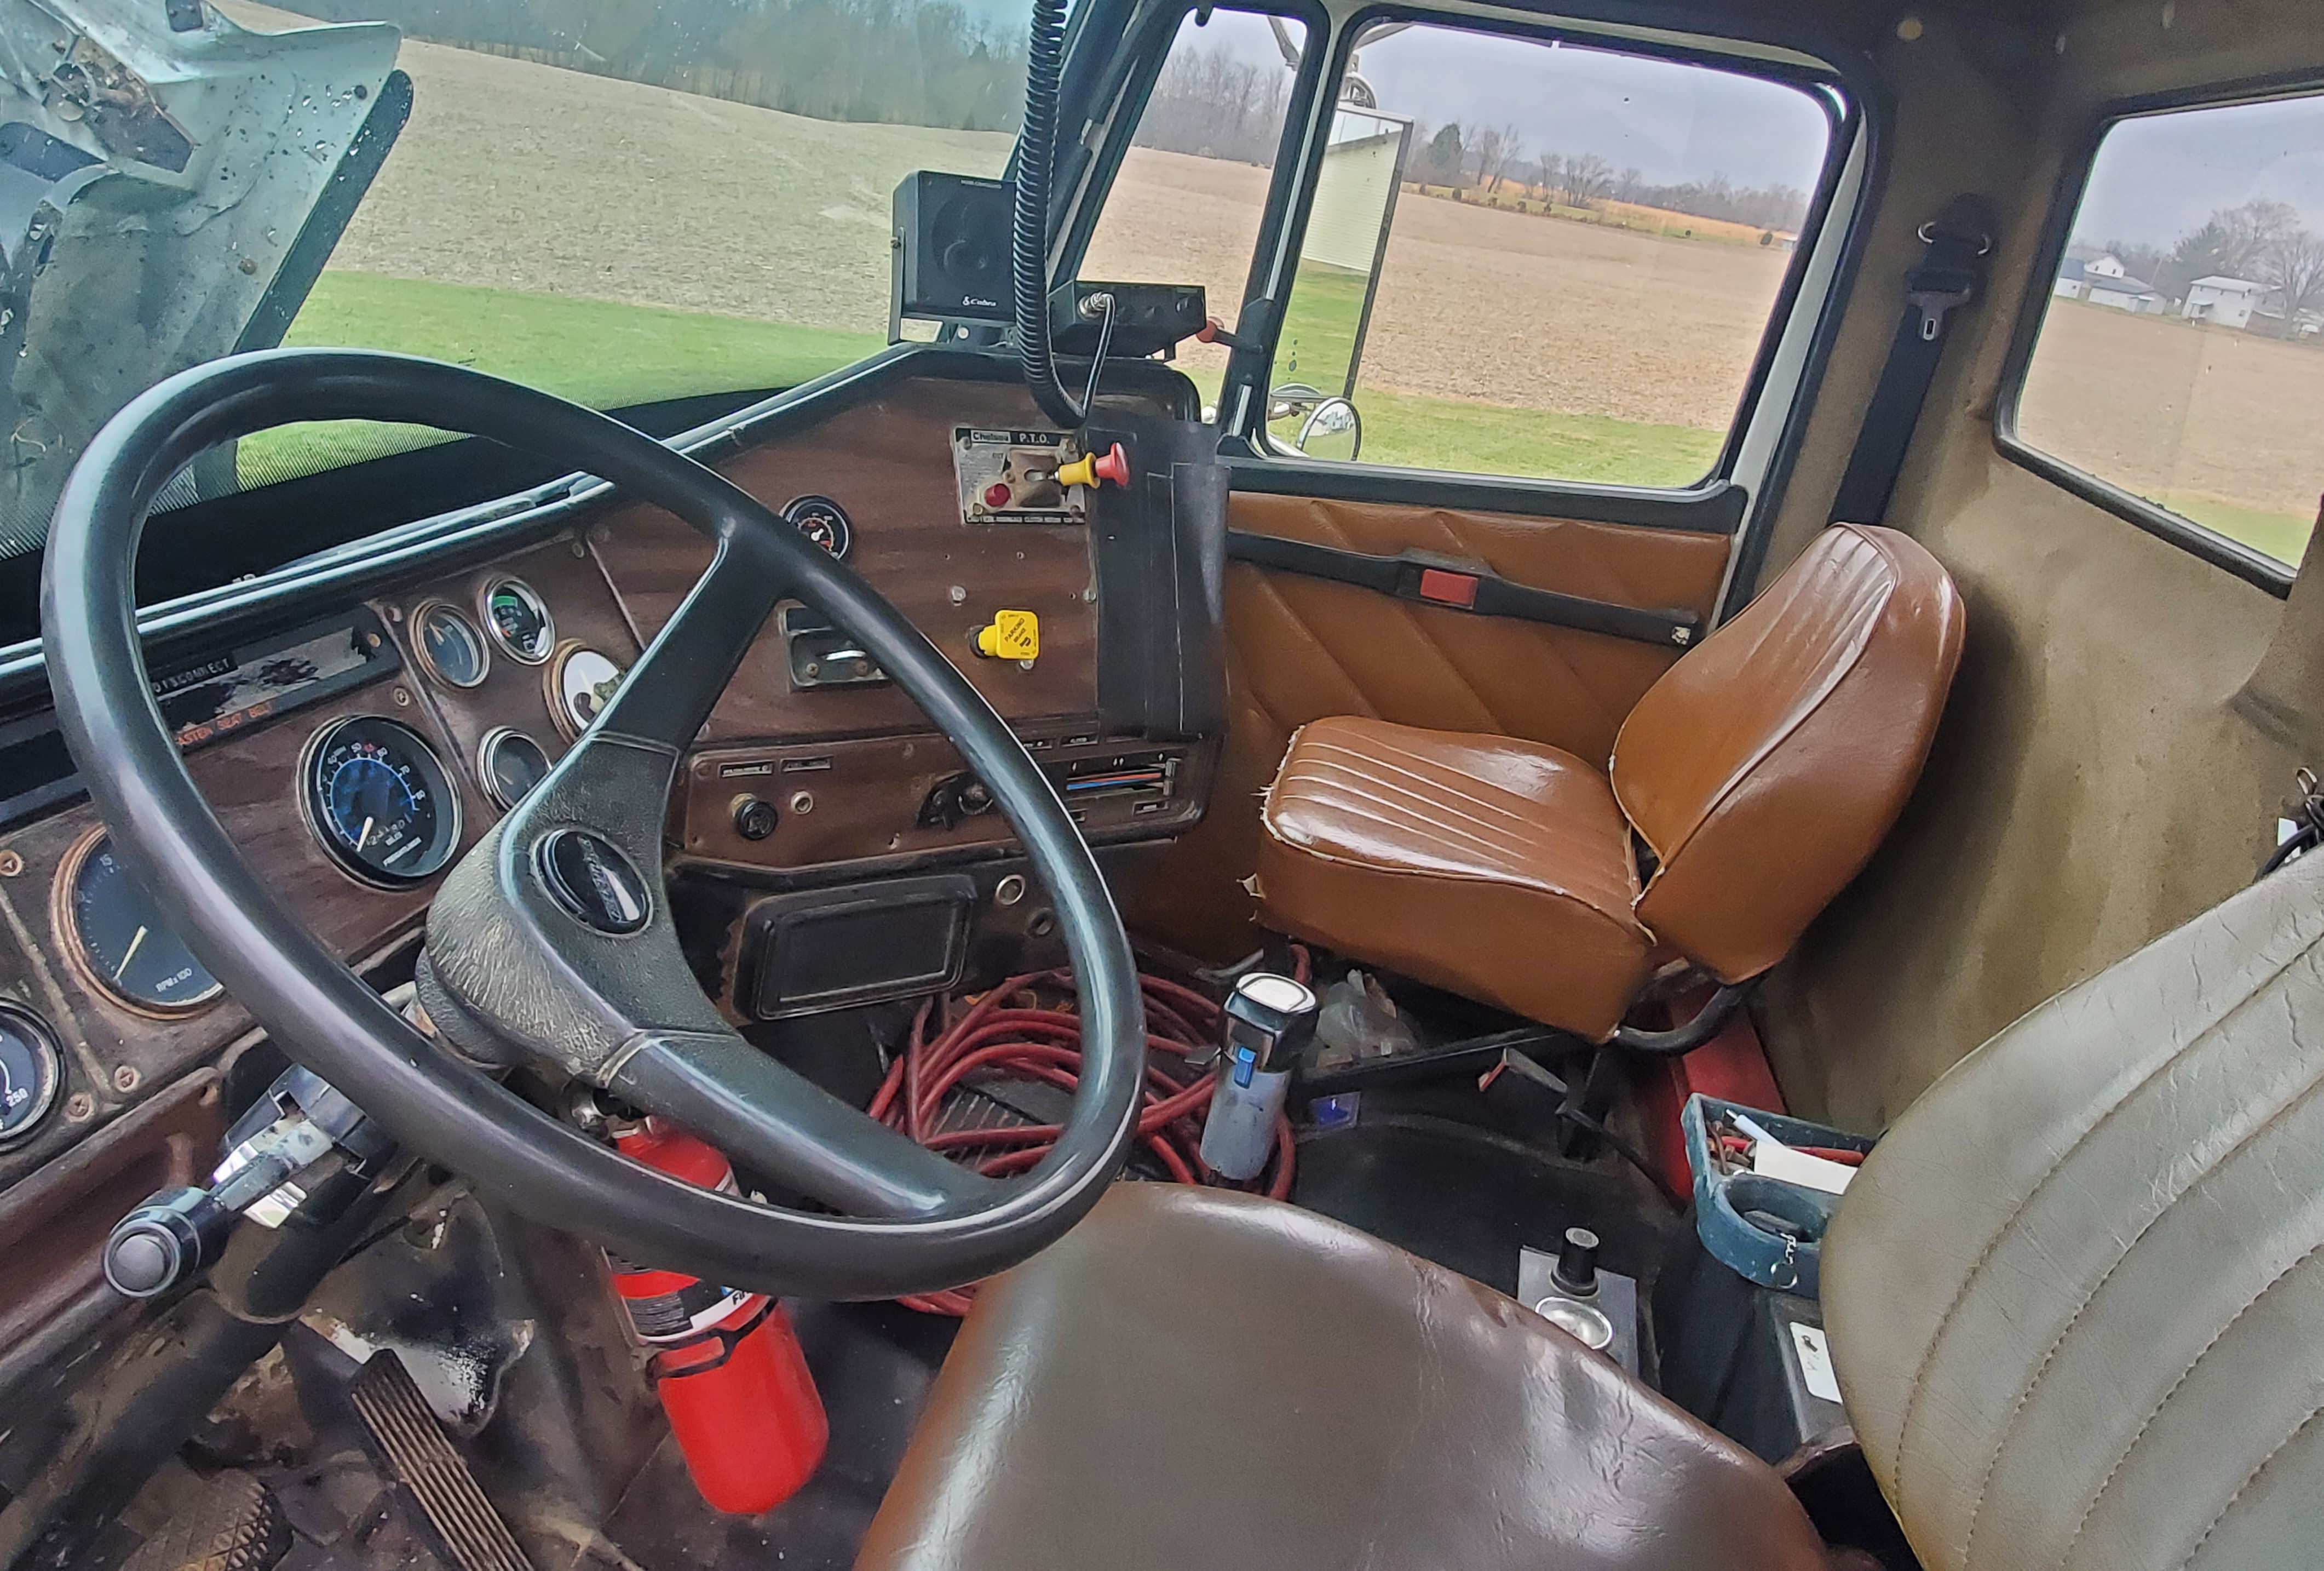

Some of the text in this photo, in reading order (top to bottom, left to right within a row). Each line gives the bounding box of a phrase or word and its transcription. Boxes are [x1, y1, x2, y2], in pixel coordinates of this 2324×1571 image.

[970, 297, 997, 307] Cobra
[1019, 433, 1049, 444] P.T.O.
[1004, 617, 1025, 642] PARKING
[177, 727, 213, 745] ASTEN
[6, 1087, 28, 1107] 250
